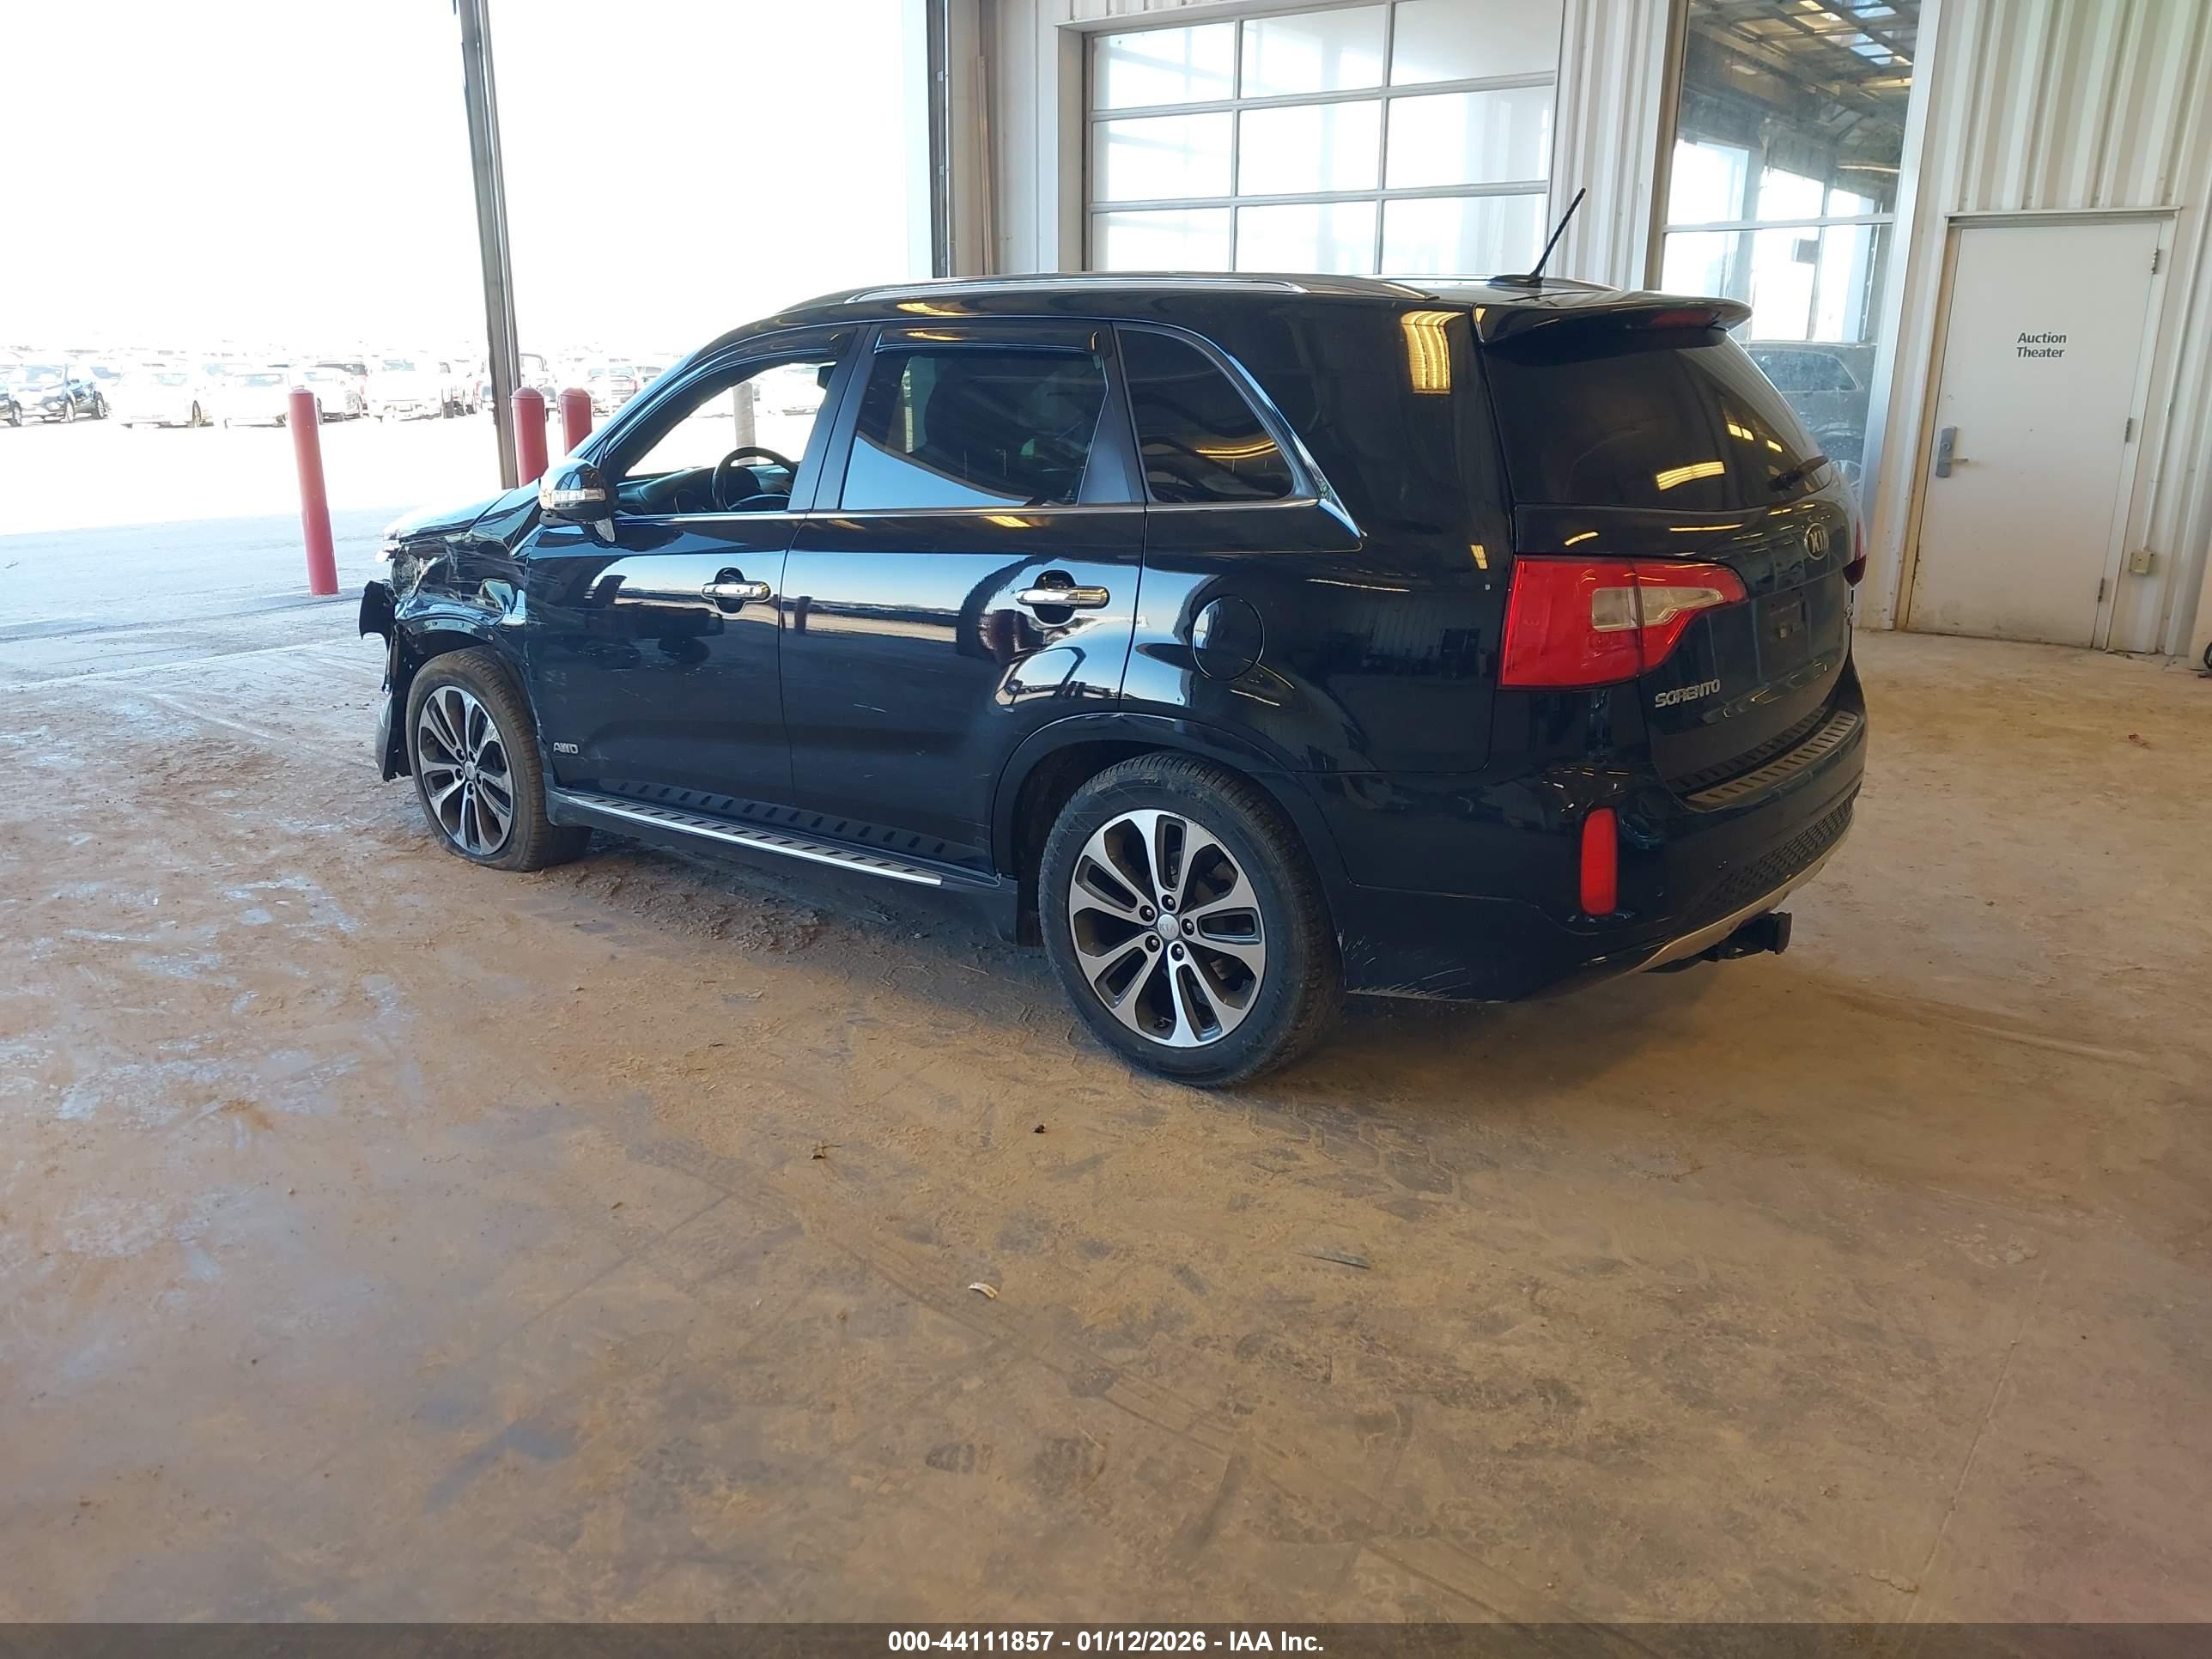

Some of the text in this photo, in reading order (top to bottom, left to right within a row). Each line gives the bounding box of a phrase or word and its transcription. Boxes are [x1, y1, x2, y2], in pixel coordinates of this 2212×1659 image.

[2016, 331, 2067, 343] Auction
[2016, 346, 2065, 358] Theater
[1655, 678, 1721, 708] SORENTO
[553, 742, 579, 754] AWD
